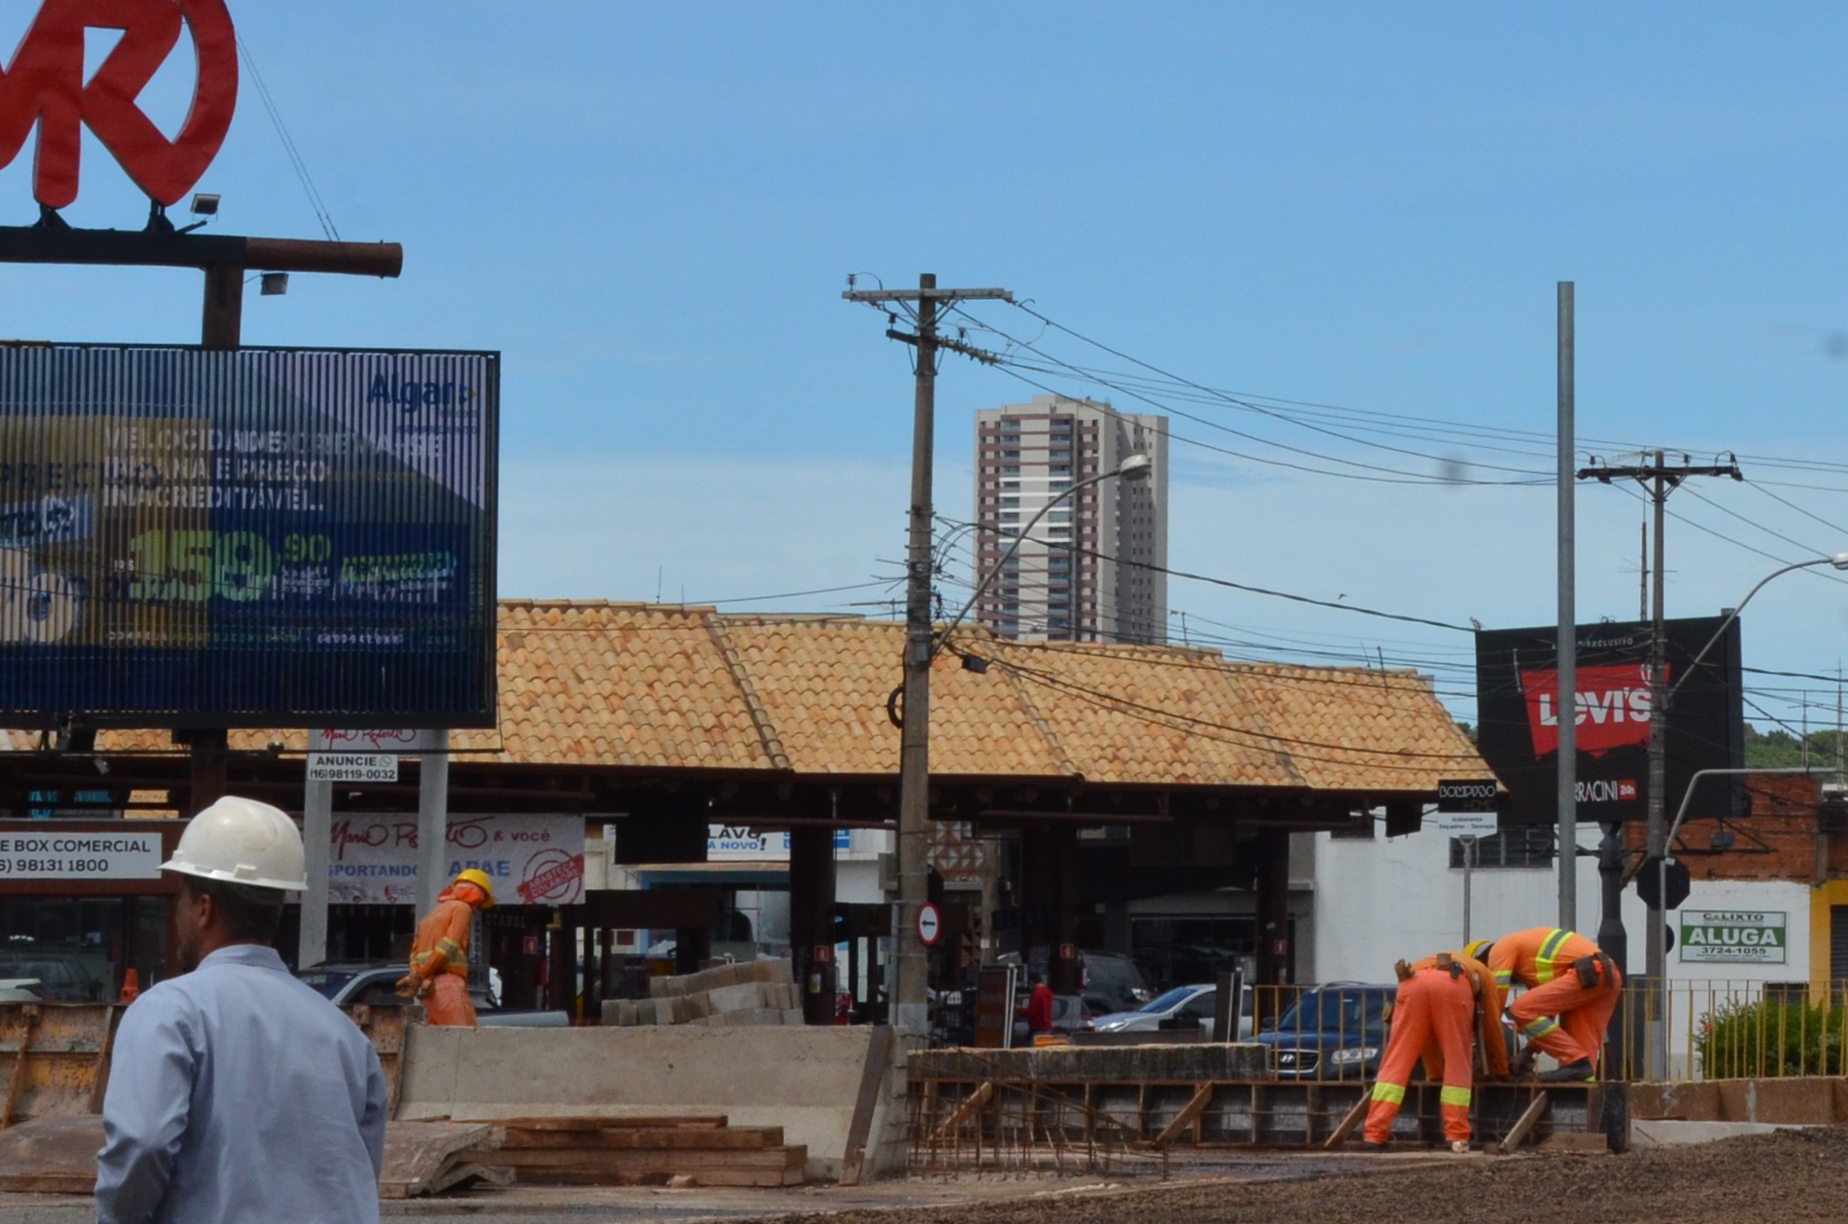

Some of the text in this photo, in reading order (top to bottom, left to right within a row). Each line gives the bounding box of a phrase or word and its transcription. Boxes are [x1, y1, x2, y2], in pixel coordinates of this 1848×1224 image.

[366, 372, 456, 414] Algar
[316, 756, 377, 766] ANUNCIE
[511, 828, 550, 842] você
[14, 839, 49, 853] BOX
[53, 839, 151, 853] COMERCIAL
[16, 859, 65, 872] 98131
[69, 859, 109, 872] 1800
[1703, 913, 1765, 922] CALIXTO
[1688, 927, 1779, 946] ALUGA
[1701, 947, 1767, 955] 3724-1055
